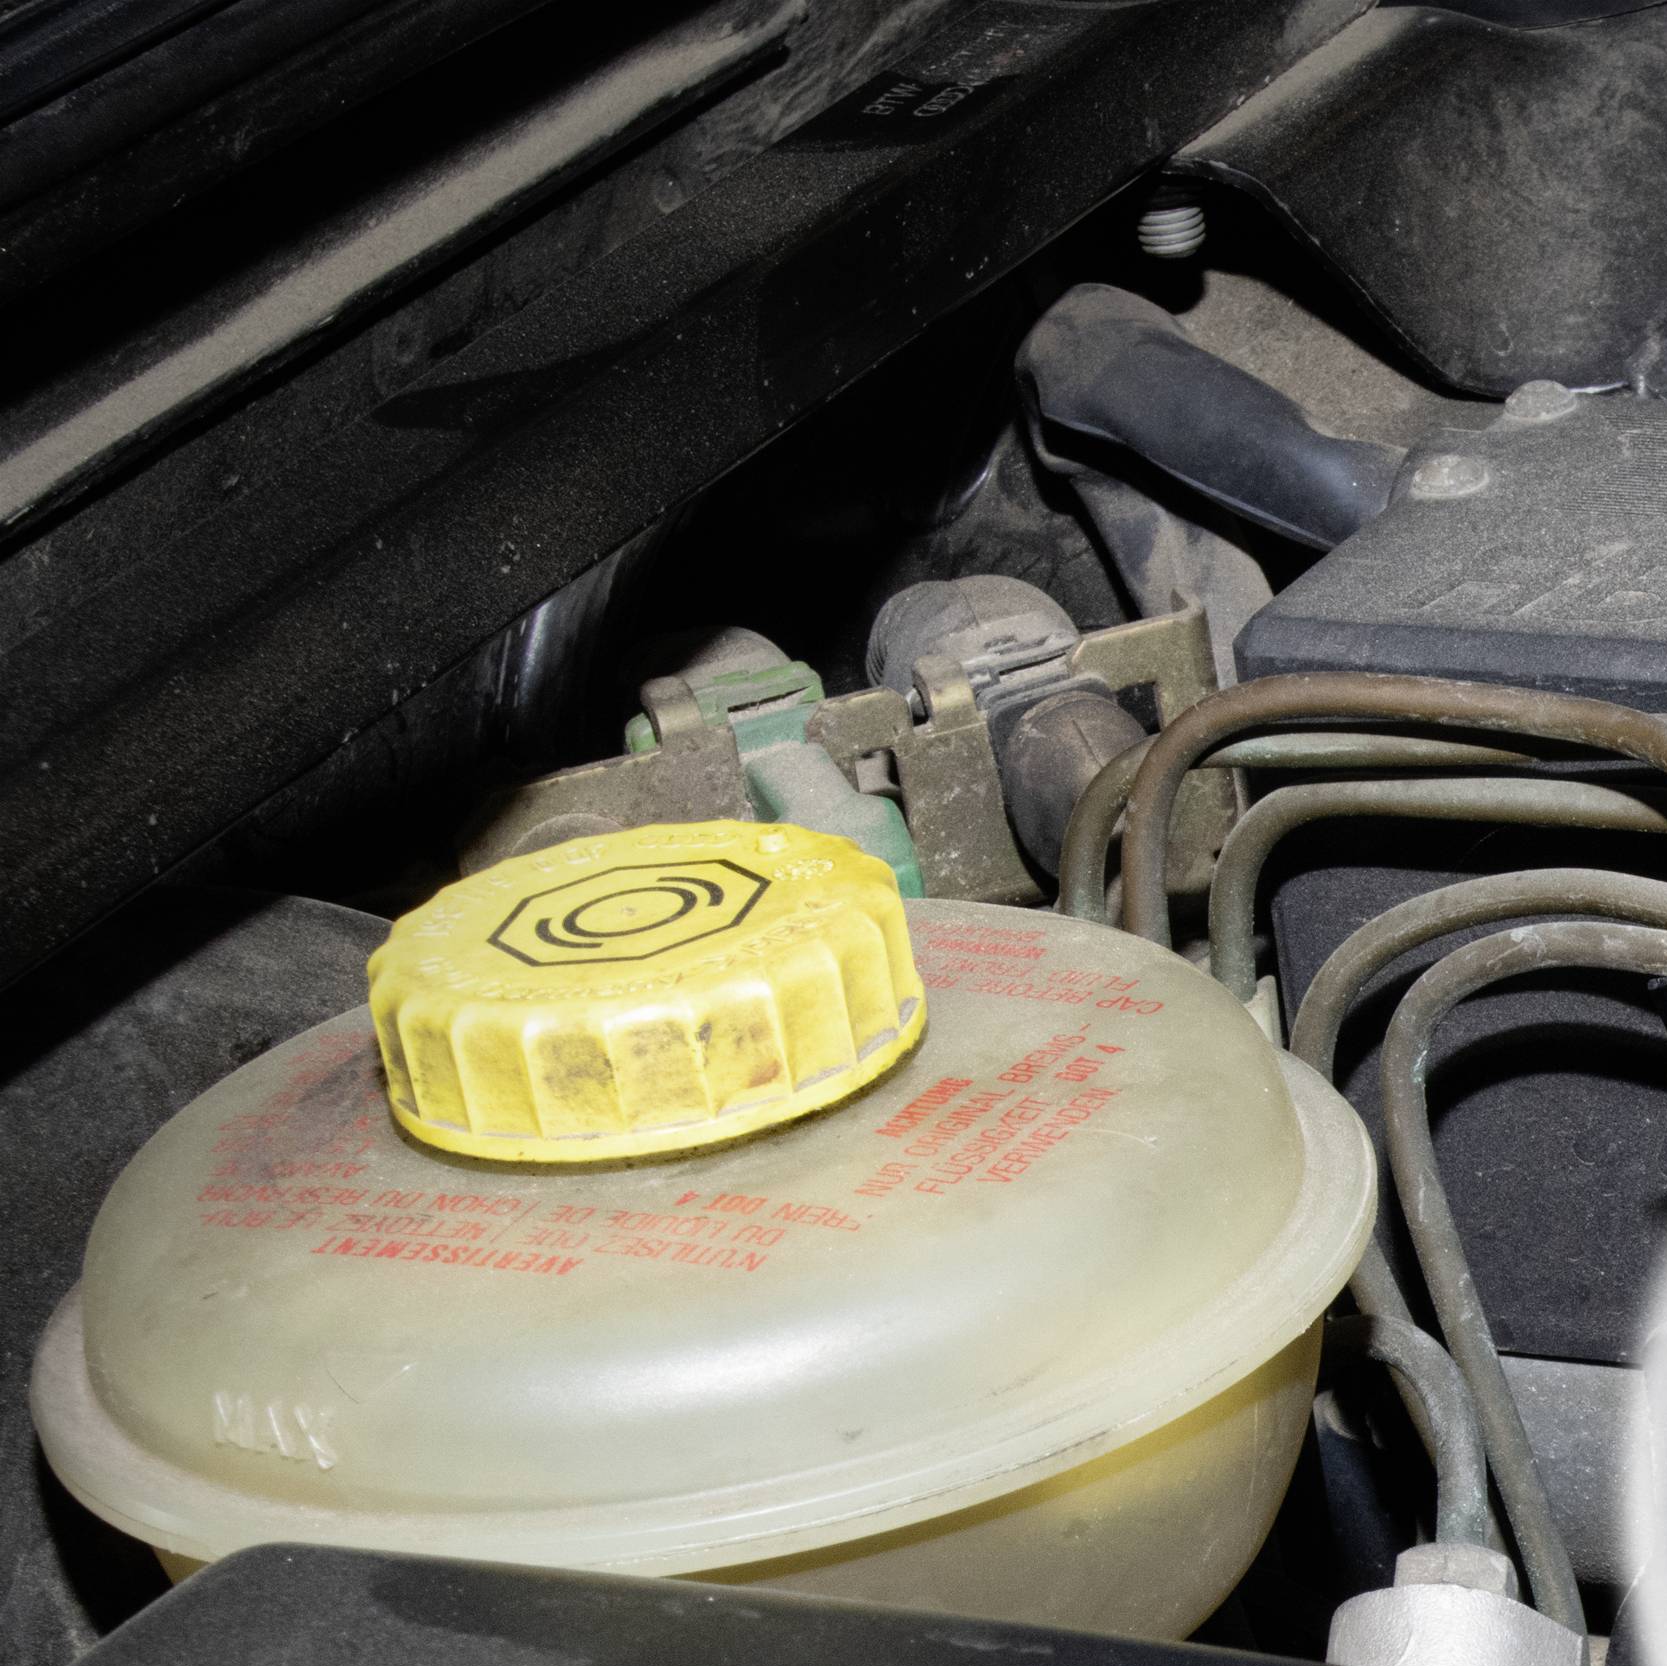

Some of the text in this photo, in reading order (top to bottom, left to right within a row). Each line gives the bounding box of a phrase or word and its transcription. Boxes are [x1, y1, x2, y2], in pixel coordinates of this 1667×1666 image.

[966, 978, 1094, 1005] BEFORE
[1095, 995, 1165, 1015] CAP
[854, 1023, 1092, 1198] NUR ORIGINAL BREMS-
[875, 1076, 974, 1139] ACHTUNG
[913, 1096, 1051, 1195] FLÜSSIGKEIT
[1055, 1056, 1105, 1083] DOT
[371, 1190, 426, 1209] DU
[674, 1190, 699, 1207] 4
[702, 1192, 769, 1216] DOT
[325, 1213, 491, 1241] NETTOYEZ
[548, 1204, 786, 1247] DU LIQUIDE DE
[311, 1236, 584, 1275] AVERTISSEMENT
